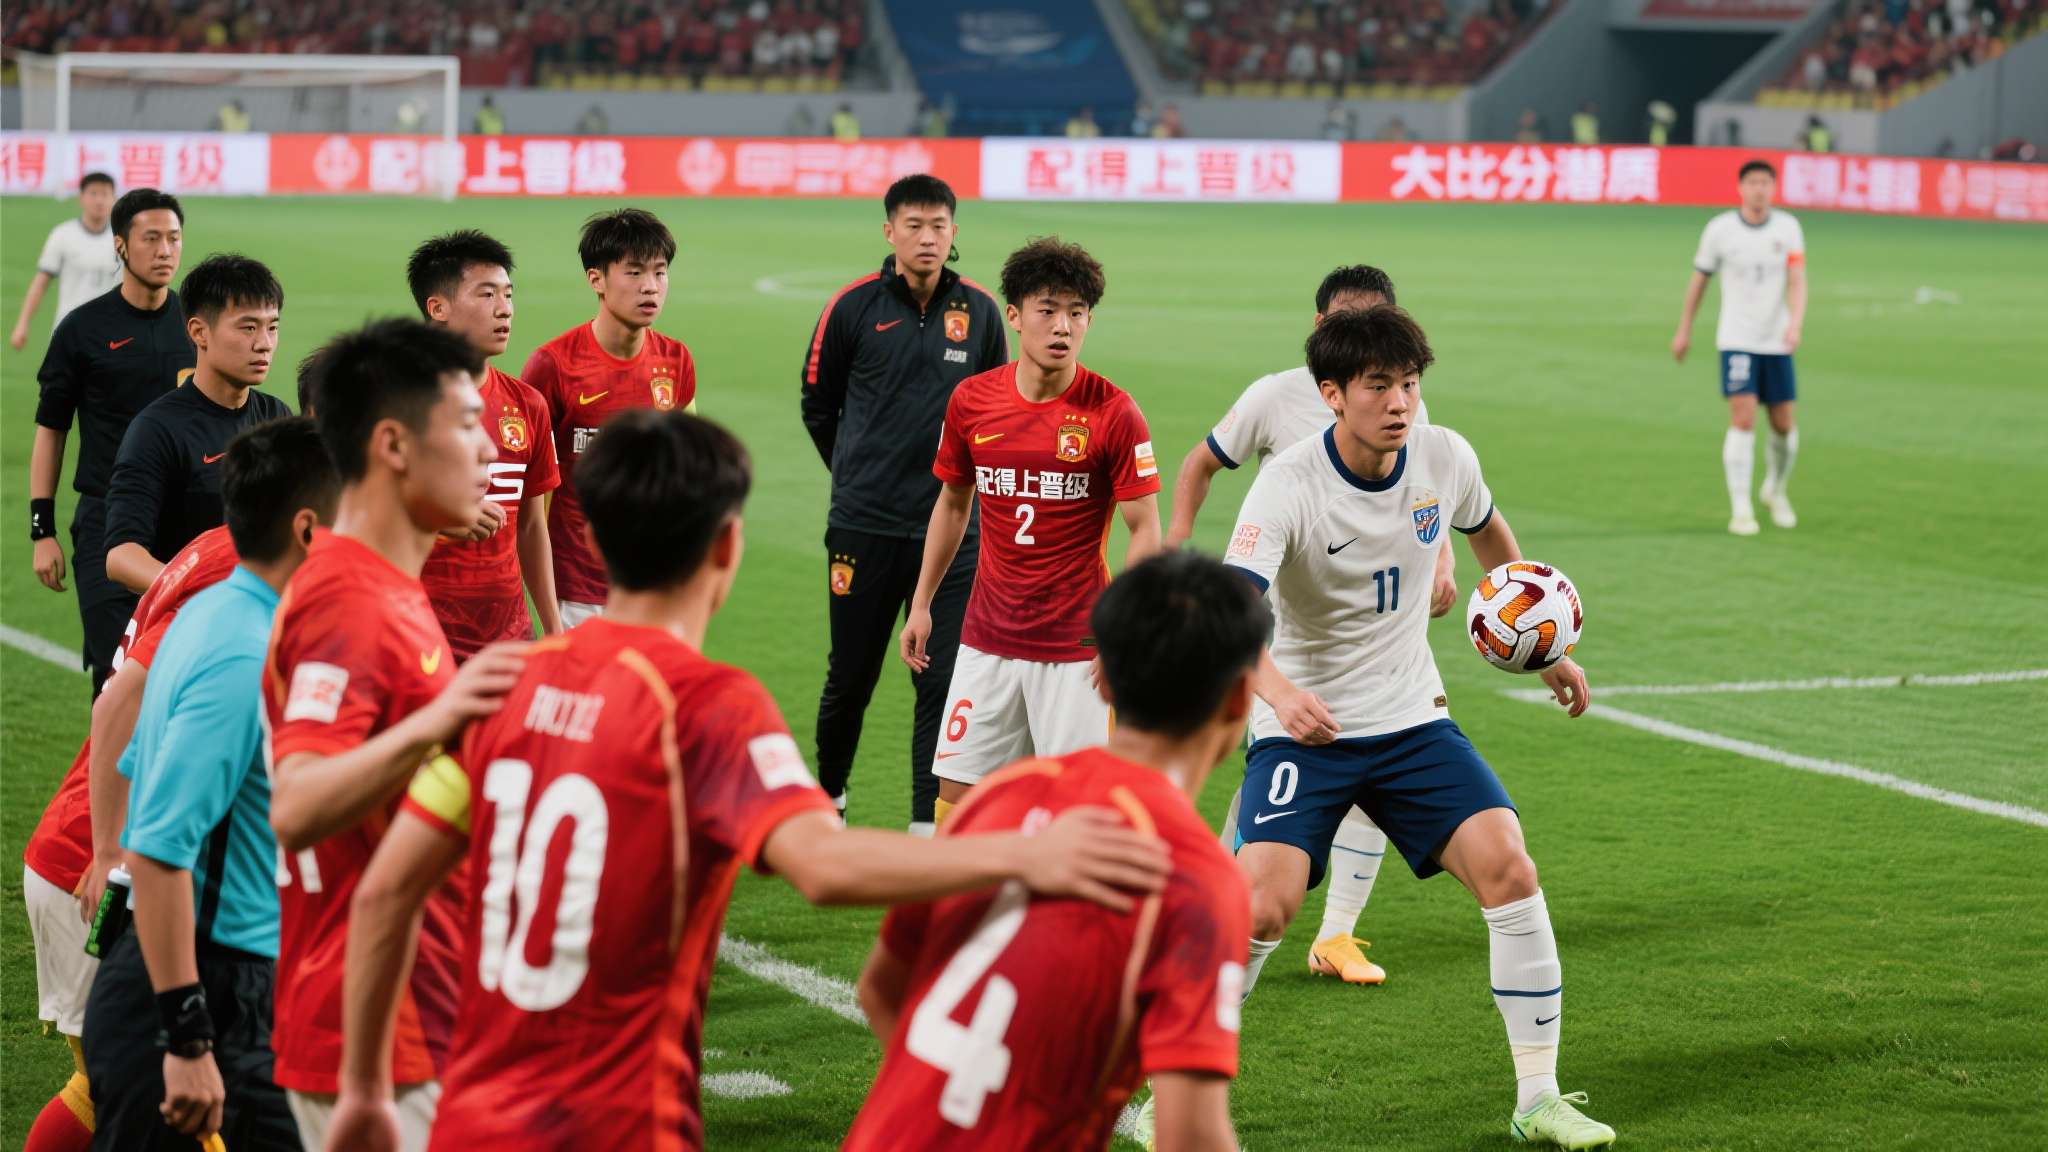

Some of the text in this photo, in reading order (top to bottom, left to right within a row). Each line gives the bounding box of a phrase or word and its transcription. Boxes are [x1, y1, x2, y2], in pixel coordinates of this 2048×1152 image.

[975, 465, 1090, 500] 配得上晋级
[1015, 503, 1035, 545] 2
[1372, 566, 1400, 614] 11
[946, 699, 973, 742] 6
[1268, 761, 1299, 806] 0
[477, 757, 609, 1012] 10
[905, 880, 1026, 1130] 4
